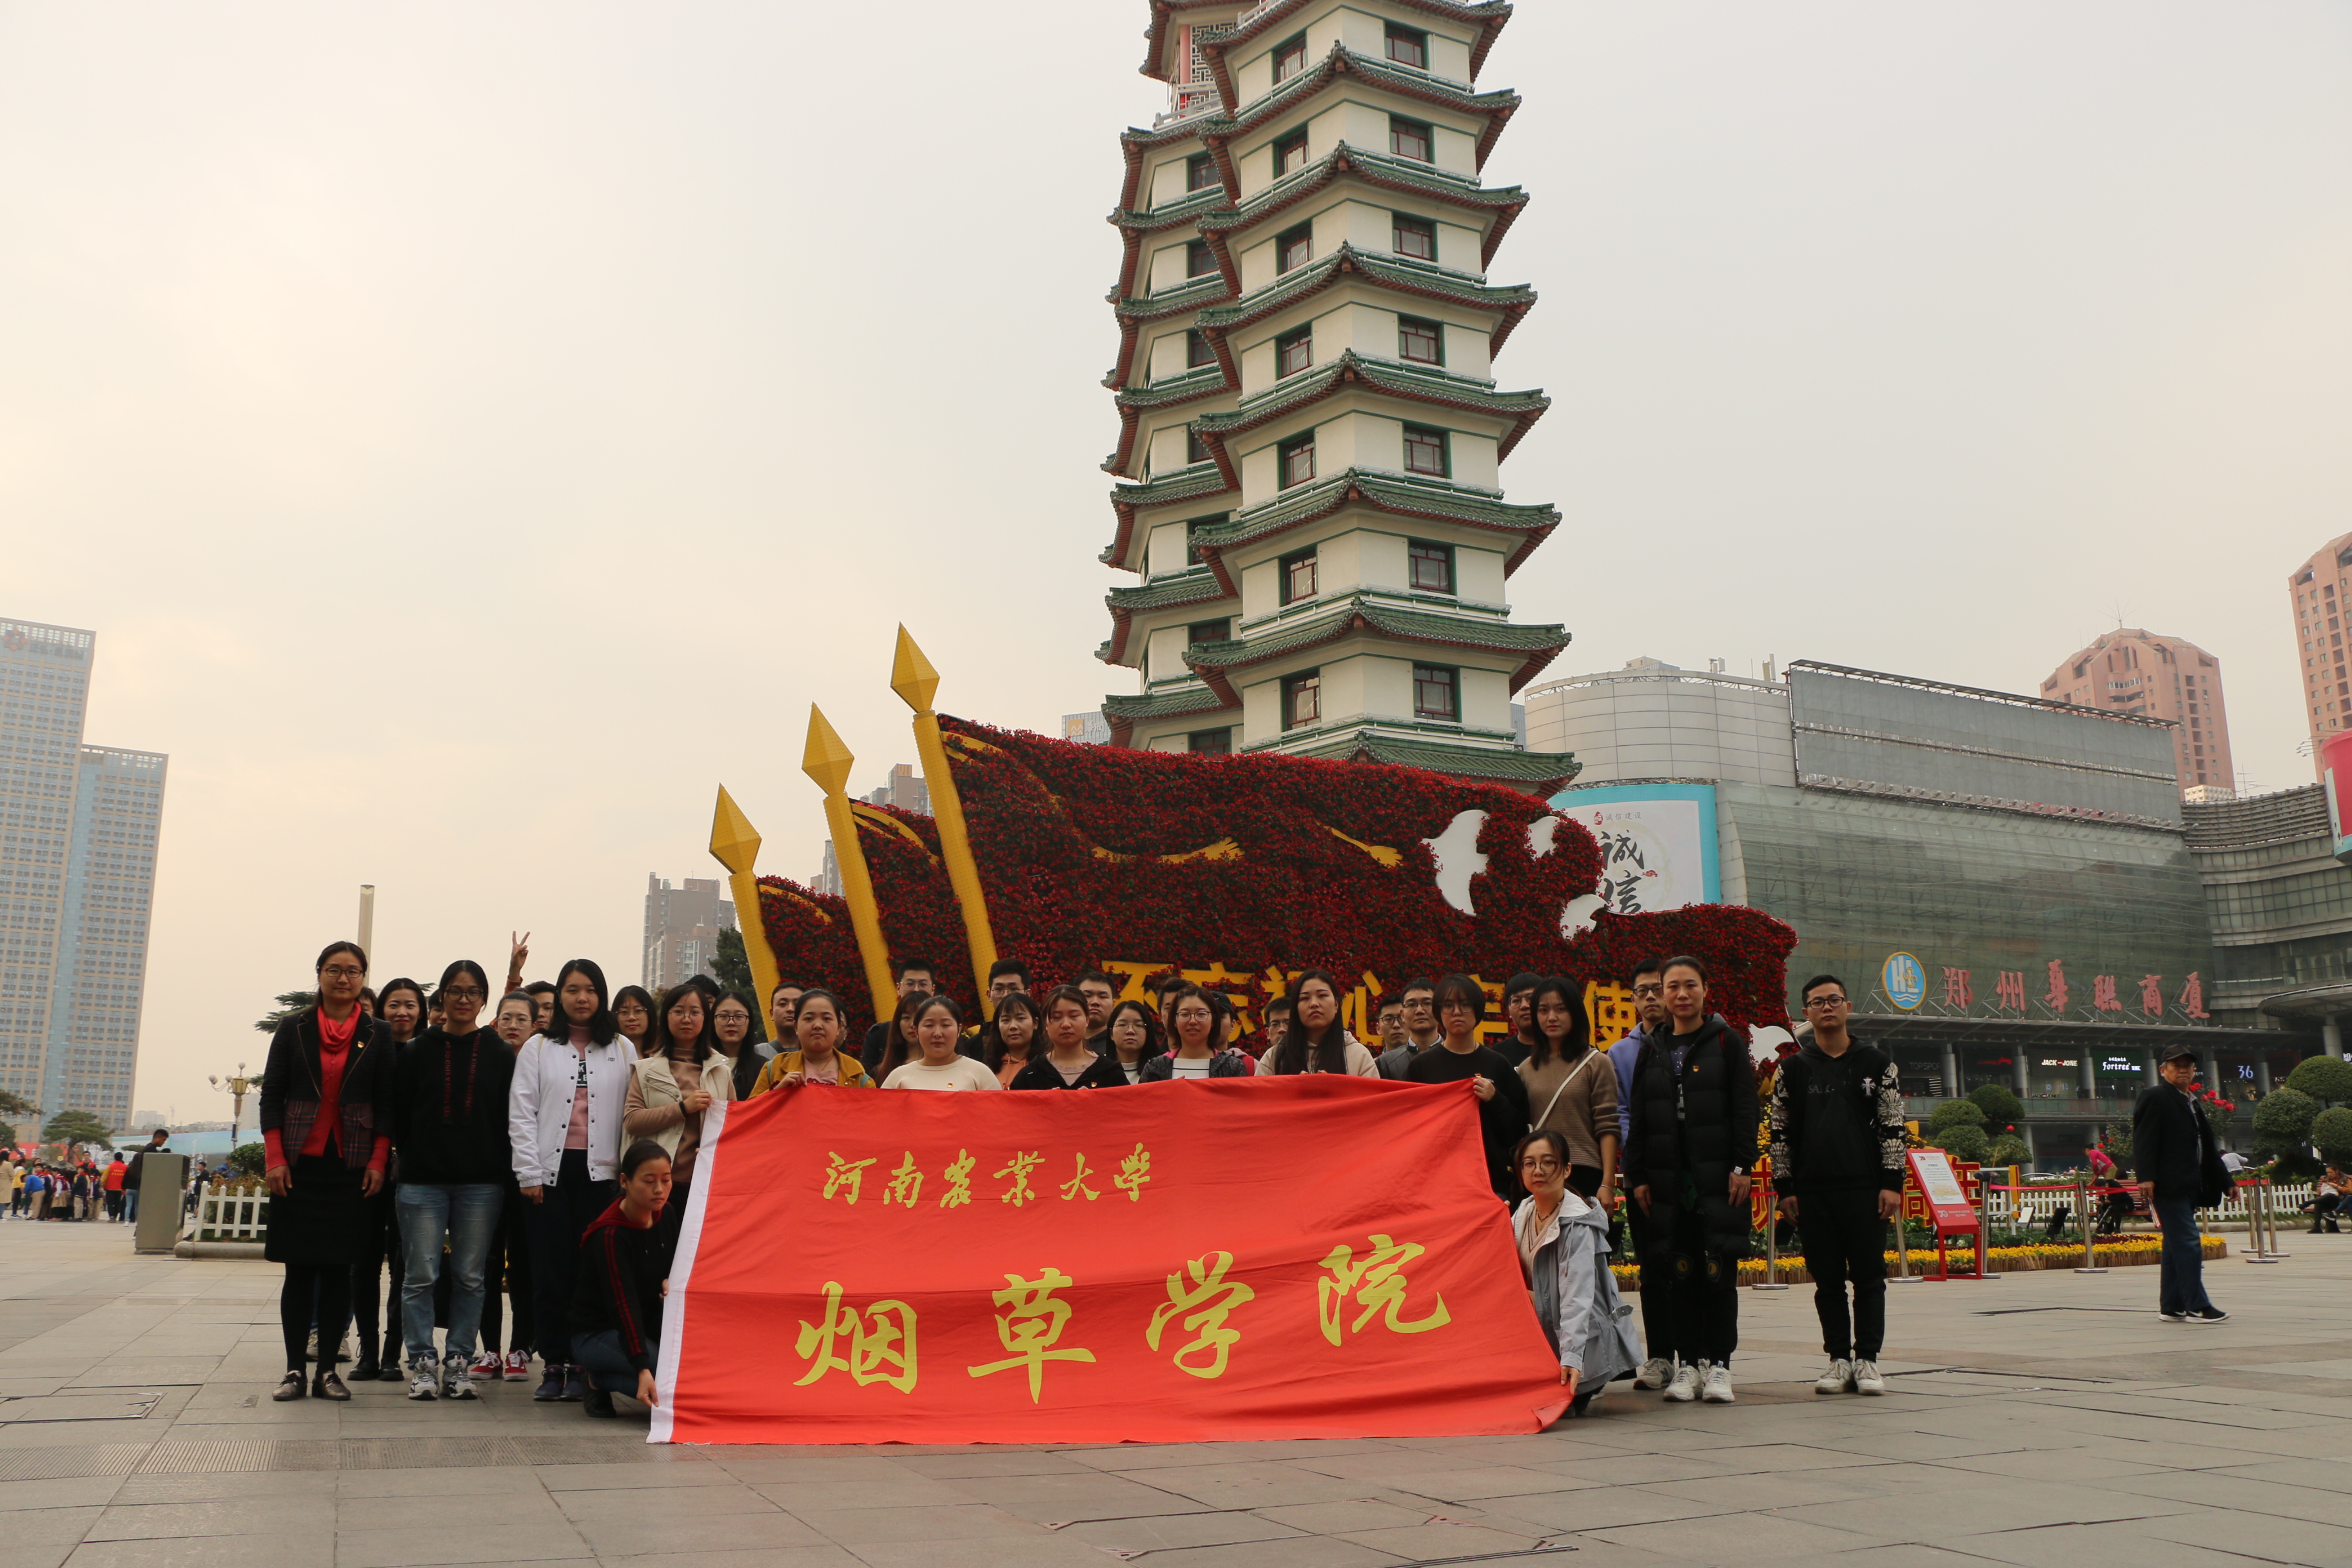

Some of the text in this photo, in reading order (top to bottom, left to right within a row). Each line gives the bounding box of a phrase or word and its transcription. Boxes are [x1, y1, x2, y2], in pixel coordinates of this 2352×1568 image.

[1605, 812, 1642, 821] 诚信建设
[2237, 1065, 2254, 1079] 36
[792, 1233, 1451, 1404] 烟草学院
